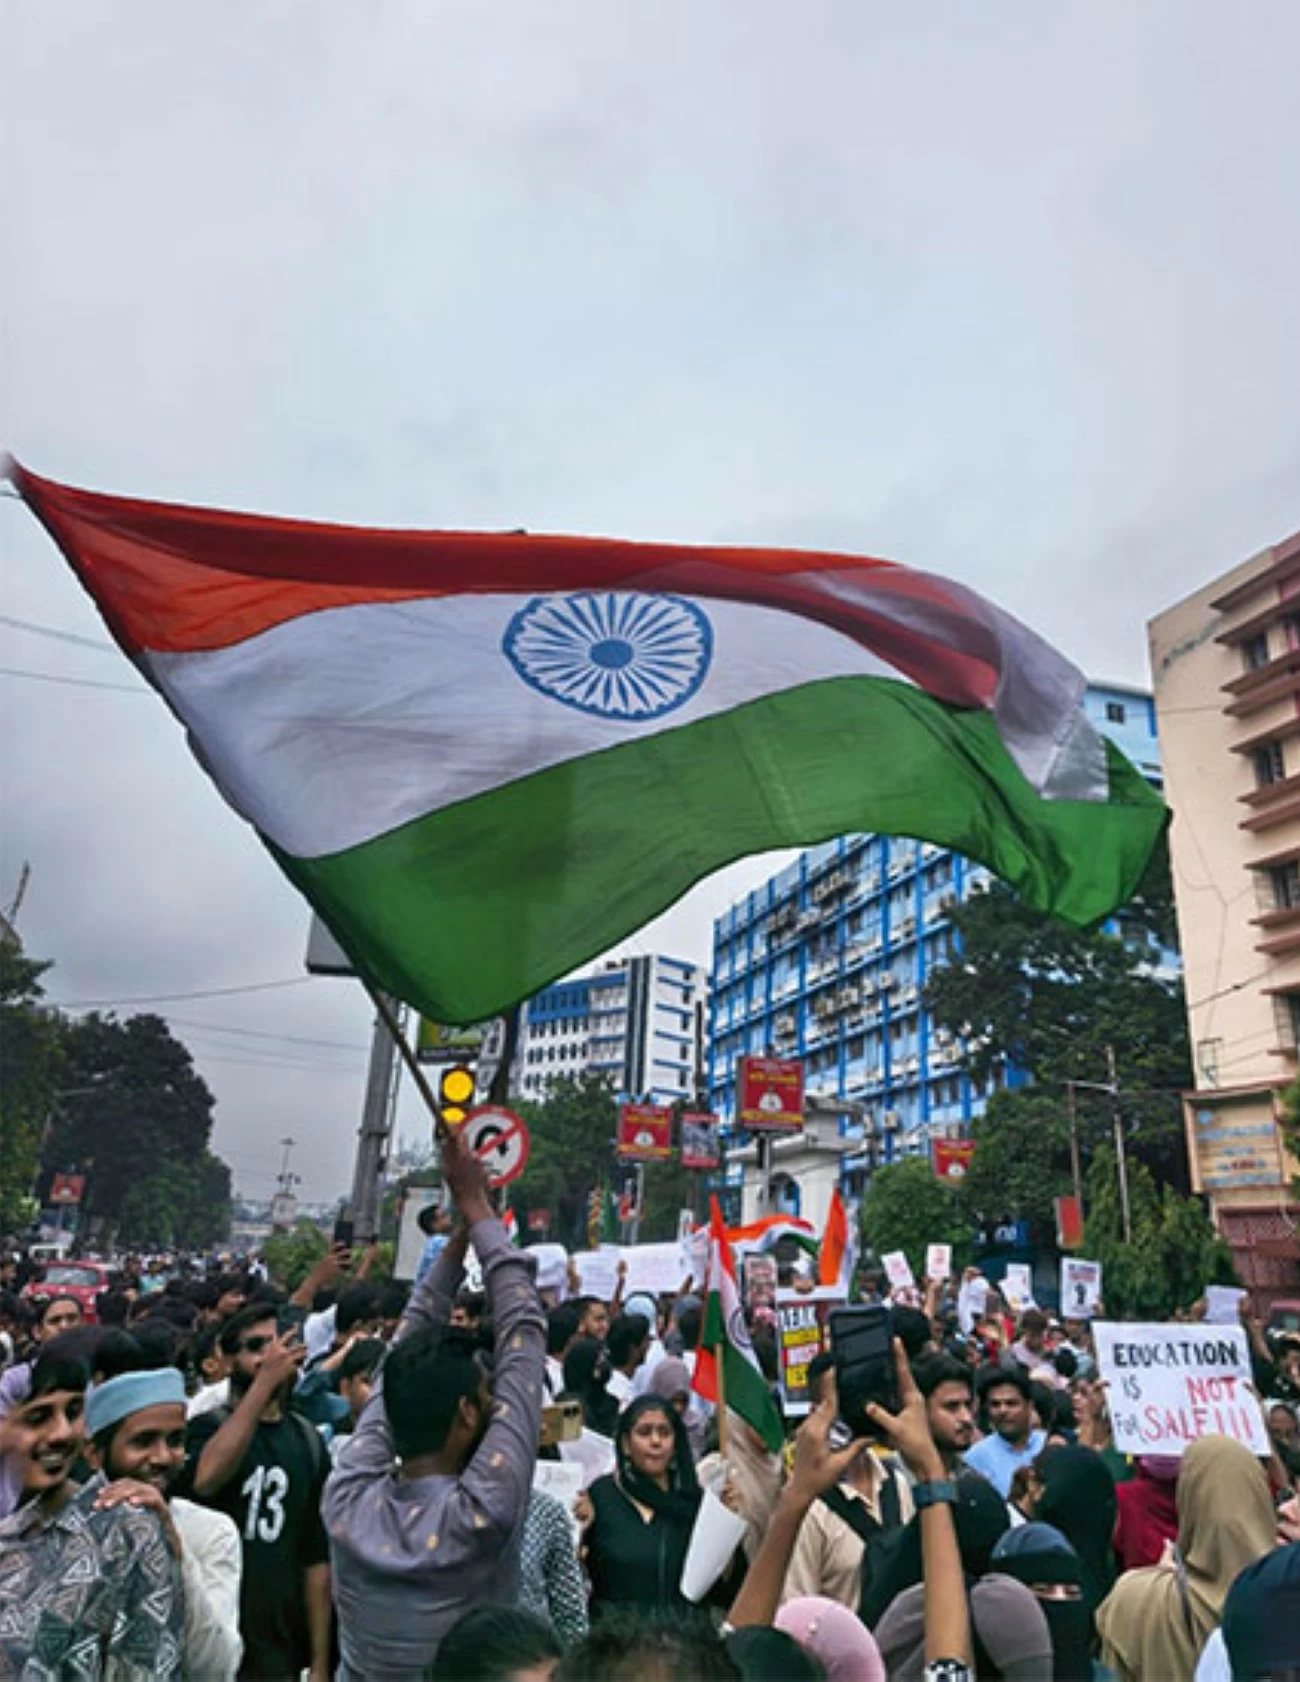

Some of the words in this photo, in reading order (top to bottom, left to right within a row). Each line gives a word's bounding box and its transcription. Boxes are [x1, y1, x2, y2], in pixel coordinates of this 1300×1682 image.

[1113, 1341, 1239, 1367] EDUCATION
[1122, 1374, 1142, 1401] IS
[1185, 1376, 1237, 1405] NOT
[242, 1465, 289, 1542] 13
